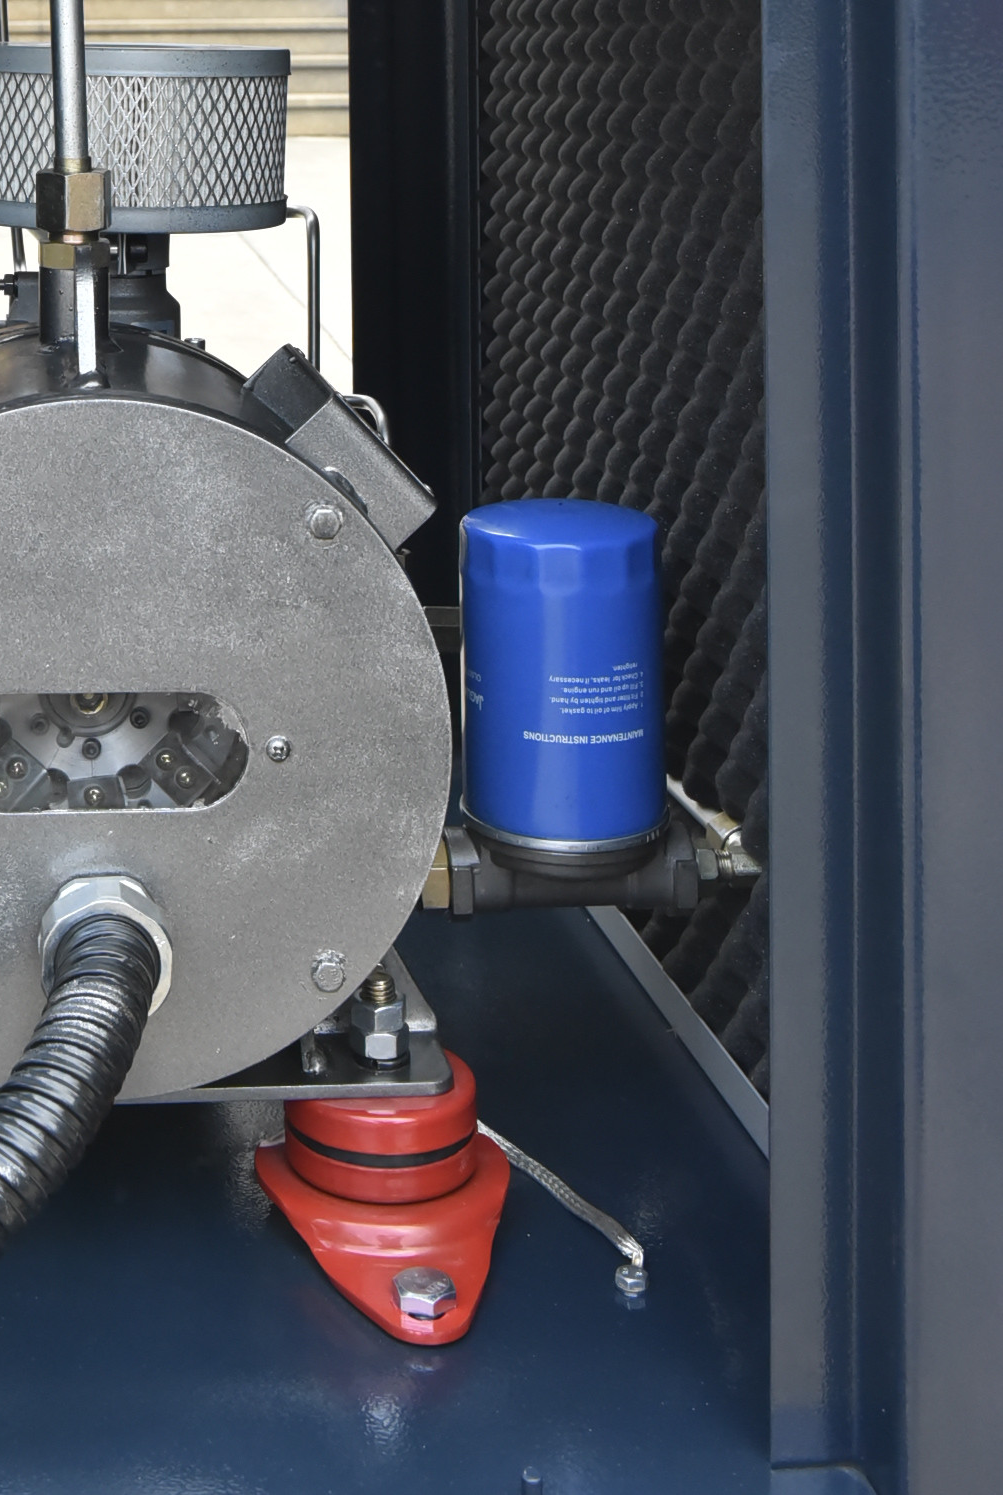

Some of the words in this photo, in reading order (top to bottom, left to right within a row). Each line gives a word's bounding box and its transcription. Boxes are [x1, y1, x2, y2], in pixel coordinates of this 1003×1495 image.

[549, 675, 584, 683] necessary
[591, 676, 610, 684] leaks,
[622, 672, 638, 681] Check
[622, 683, 629, 691] up
[549, 696, 569, 704] hand.
[570, 697, 578, 705] by
[580, 696, 603, 704] tighten
[623, 702, 638, 711] Apply
[523, 730, 588, 744] INSTRUCTIONS
[590, 729, 644, 744] MAINTENANCE
